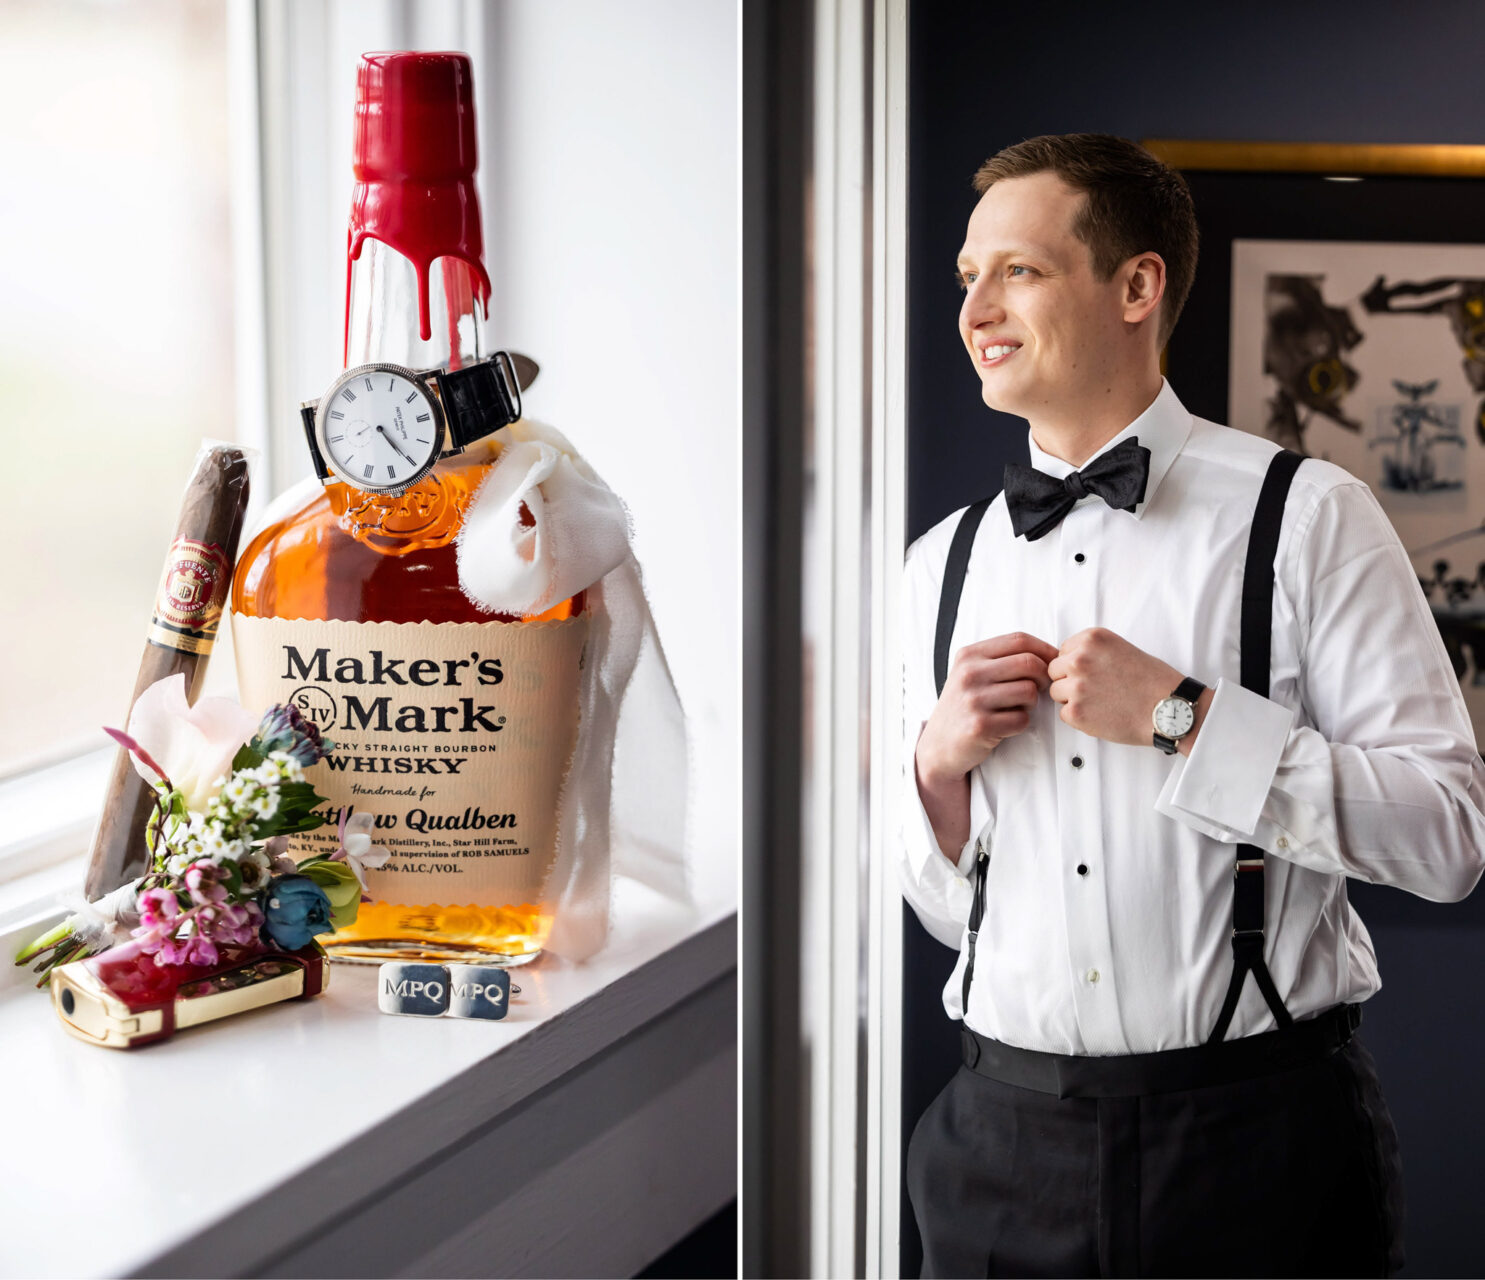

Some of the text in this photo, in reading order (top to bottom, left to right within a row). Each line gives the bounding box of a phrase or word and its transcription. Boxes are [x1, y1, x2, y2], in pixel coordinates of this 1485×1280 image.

[179, 560, 212, 583] FUENTE
[176, 601, 205, 612] RESERVA
[281, 645, 505, 687] Maker's
[365, 743, 428, 753] STRAIGHT
[434, 744, 497, 753] BOURBON
[325, 755, 468, 775] WHISKY
[351, 784, 437, 801] Handmade for
[405, 806, 518, 834] Qualben
[301, 833, 311, 842] by
[313, 834, 327, 842] the
[389, 839, 431, 848] Distillery,
[453, 839, 471, 847] Star
[473, 838, 490, 846] Hill
[399, 851, 449, 859] supervision
[451, 850, 460, 858] of
[462, 850, 482, 858] ROB
[484, 847, 530, 857] SAMUELS
[401, 863, 464, 874] ALC./VOL.
[385, 979, 443, 1004] MPQ
[451, 983, 503, 1005] MPQ
